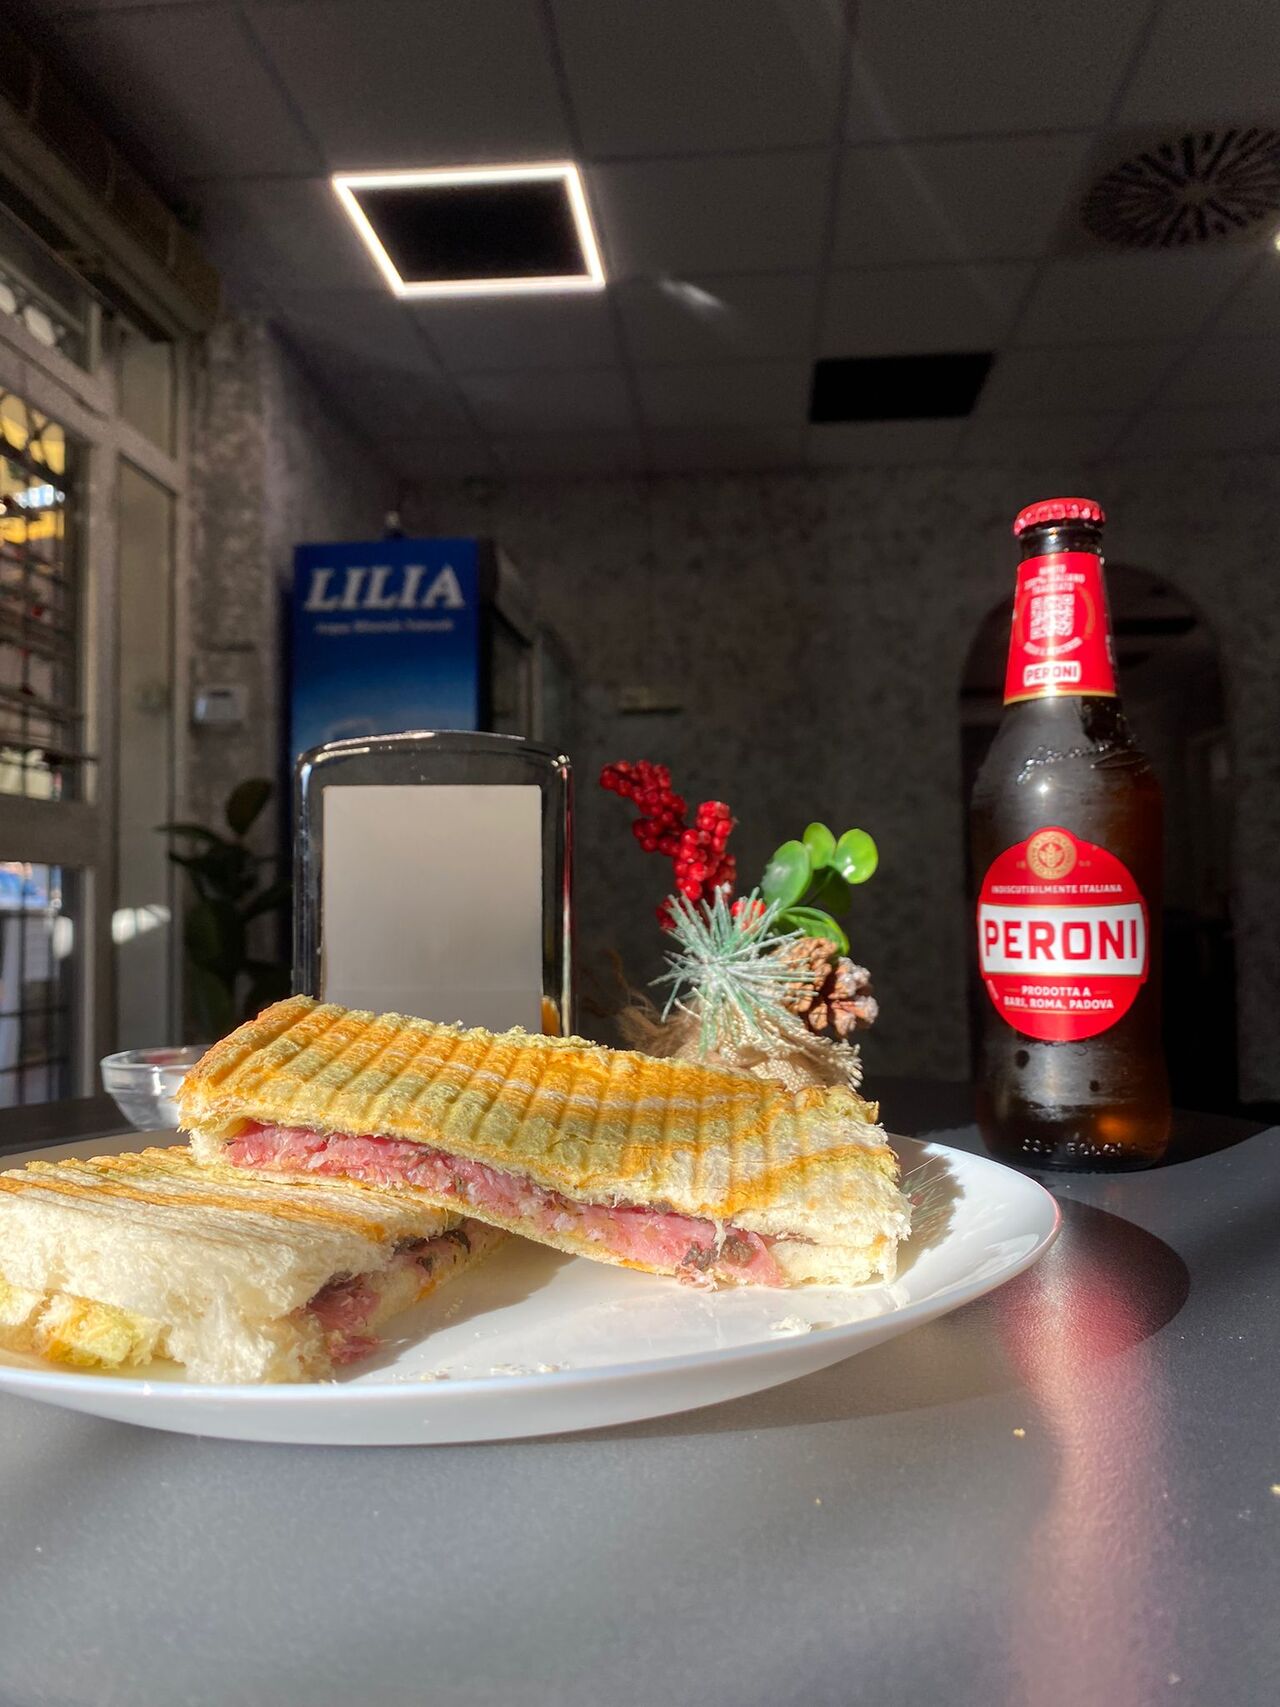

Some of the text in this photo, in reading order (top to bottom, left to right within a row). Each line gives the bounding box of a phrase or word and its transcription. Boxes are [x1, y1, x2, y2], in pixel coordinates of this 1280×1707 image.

[304, 564, 466, 612] LILIA
[1025, 664, 1078, 682] PERONI
[991, 884, 1122, 894] INDISCUTIBILMENTE ITALIANA
[984, 919, 1138, 961] PERONI
[1021, 985, 1092, 997] PRODOTTA A
[1003, 995, 1115, 1010] BARI, ROMA, PADOVA
